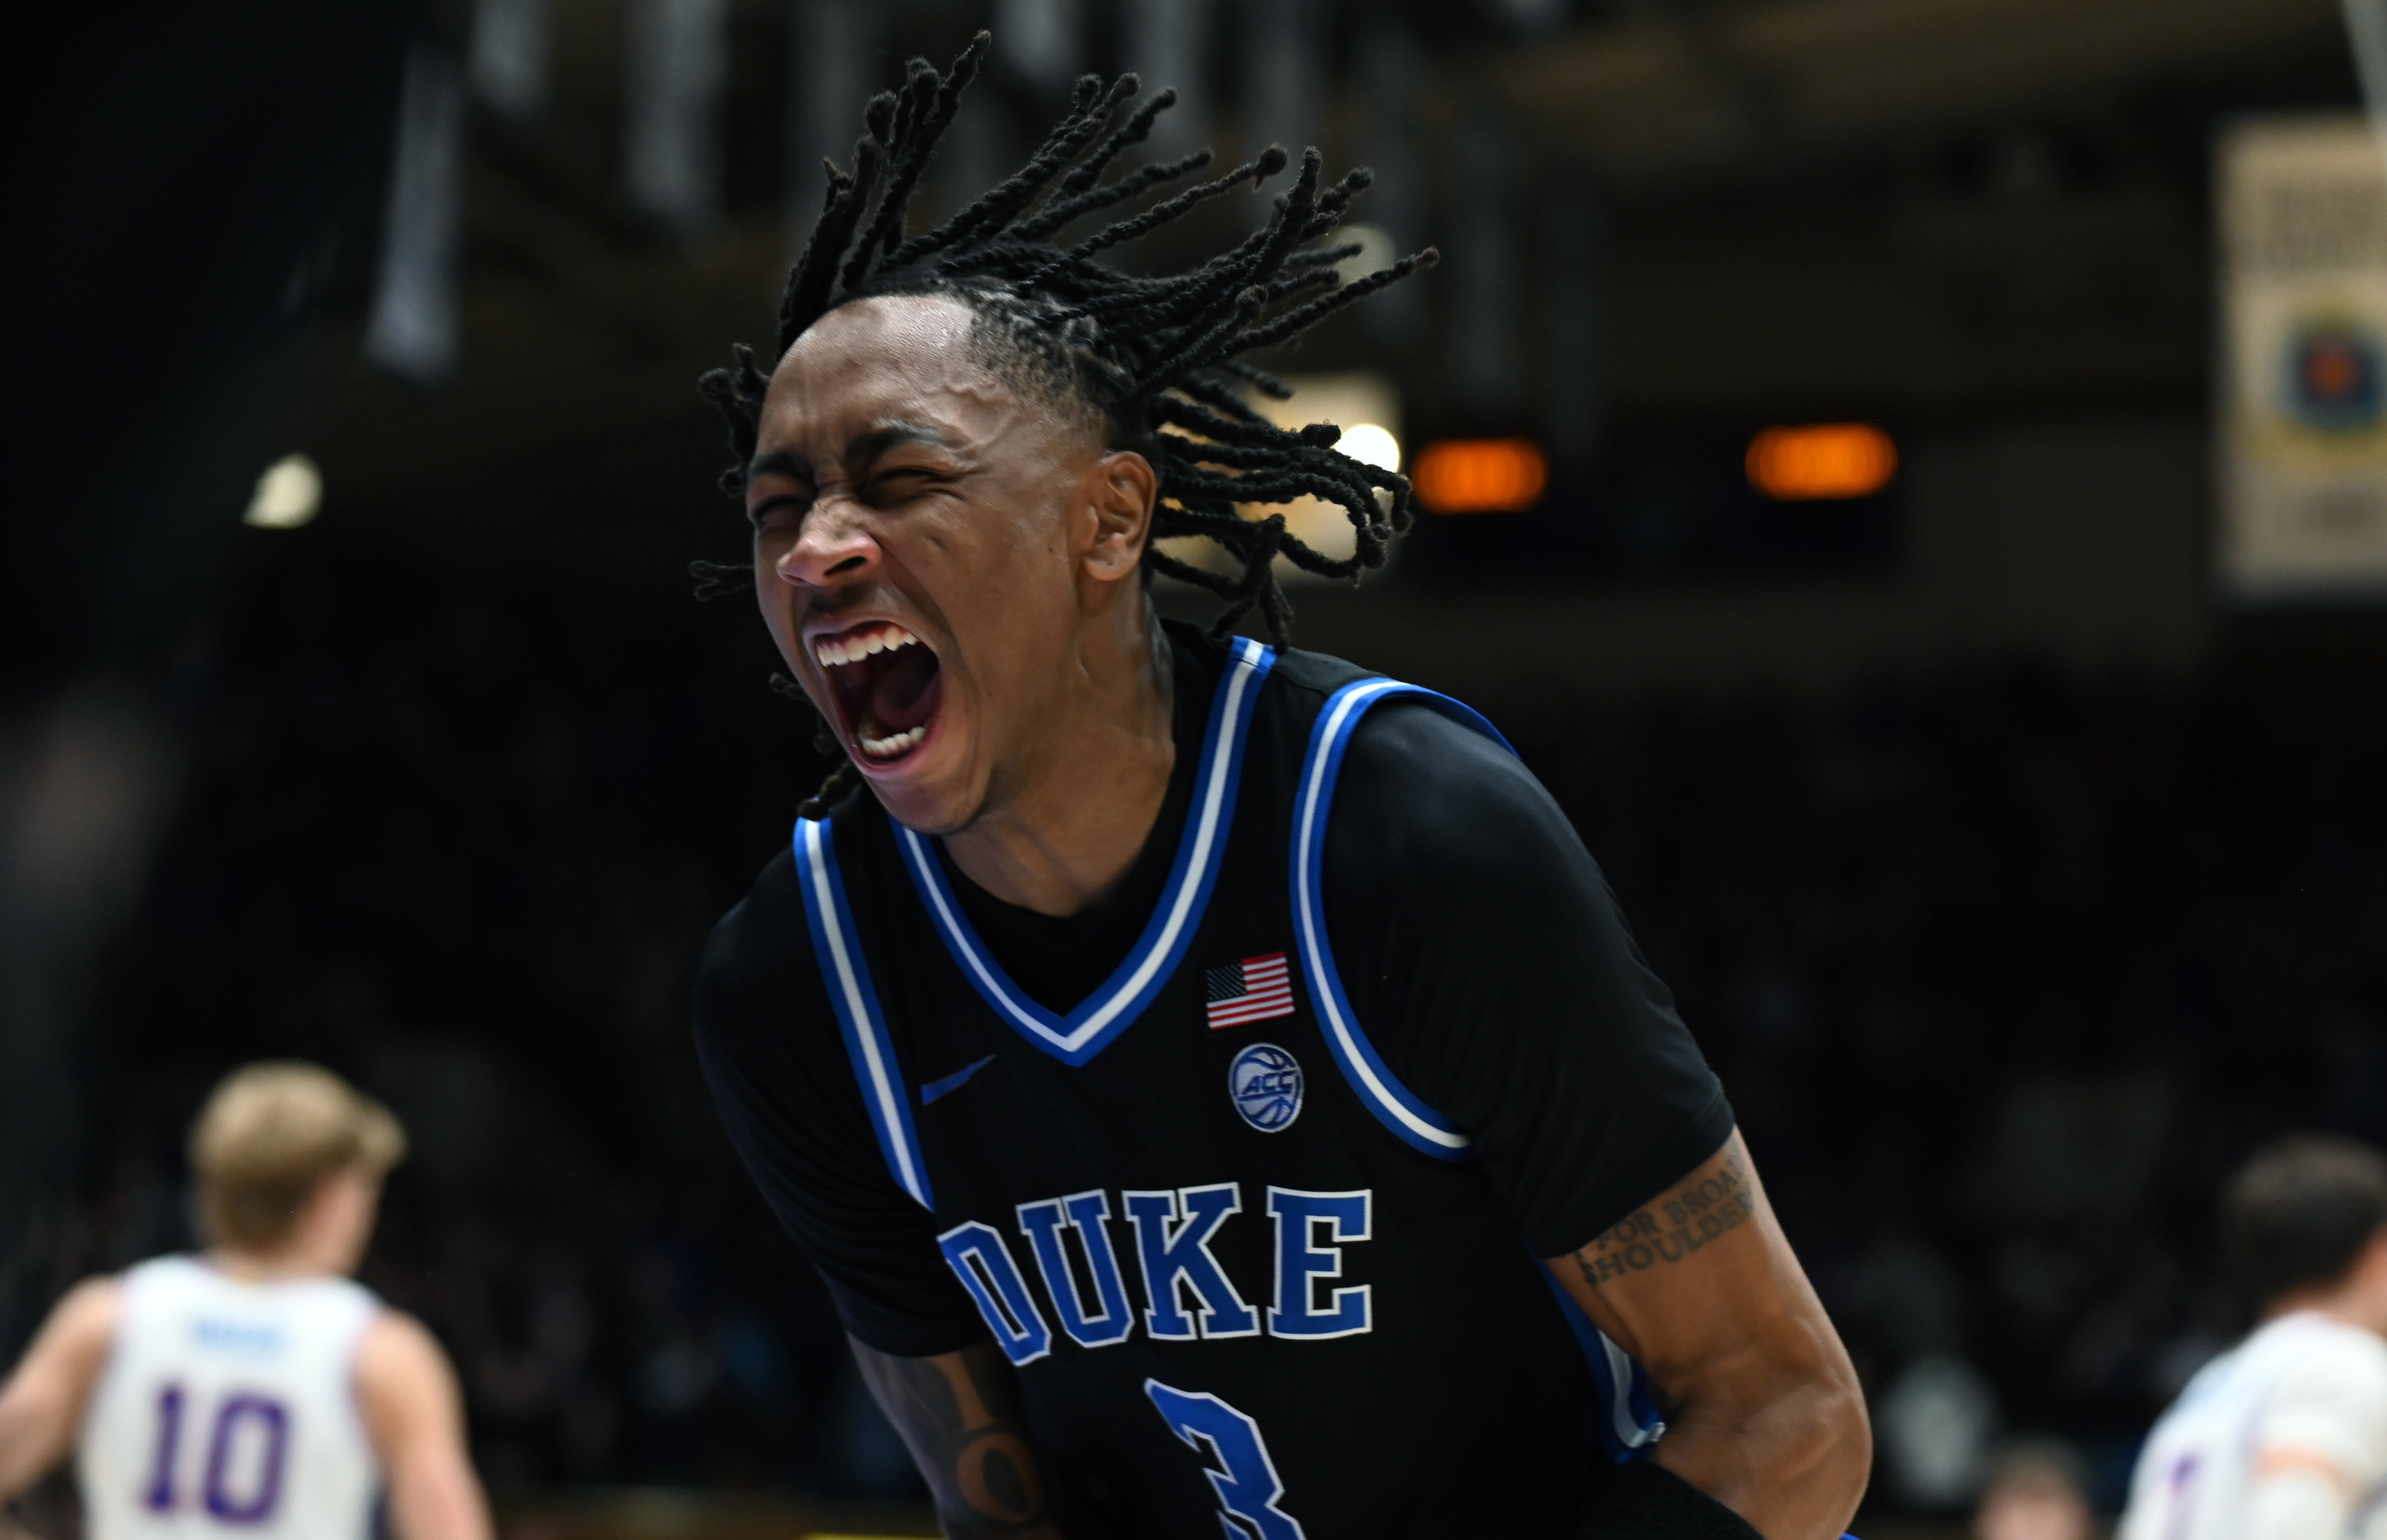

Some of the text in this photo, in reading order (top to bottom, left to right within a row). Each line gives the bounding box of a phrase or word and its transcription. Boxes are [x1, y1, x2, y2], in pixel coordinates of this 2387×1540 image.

[1241, 1071, 1296, 1095] ACC
[937, 1181, 1372, 1366] DUKE
[138, 1382, 292, 1527] 10
[1143, 1377, 1307, 1540] 3
